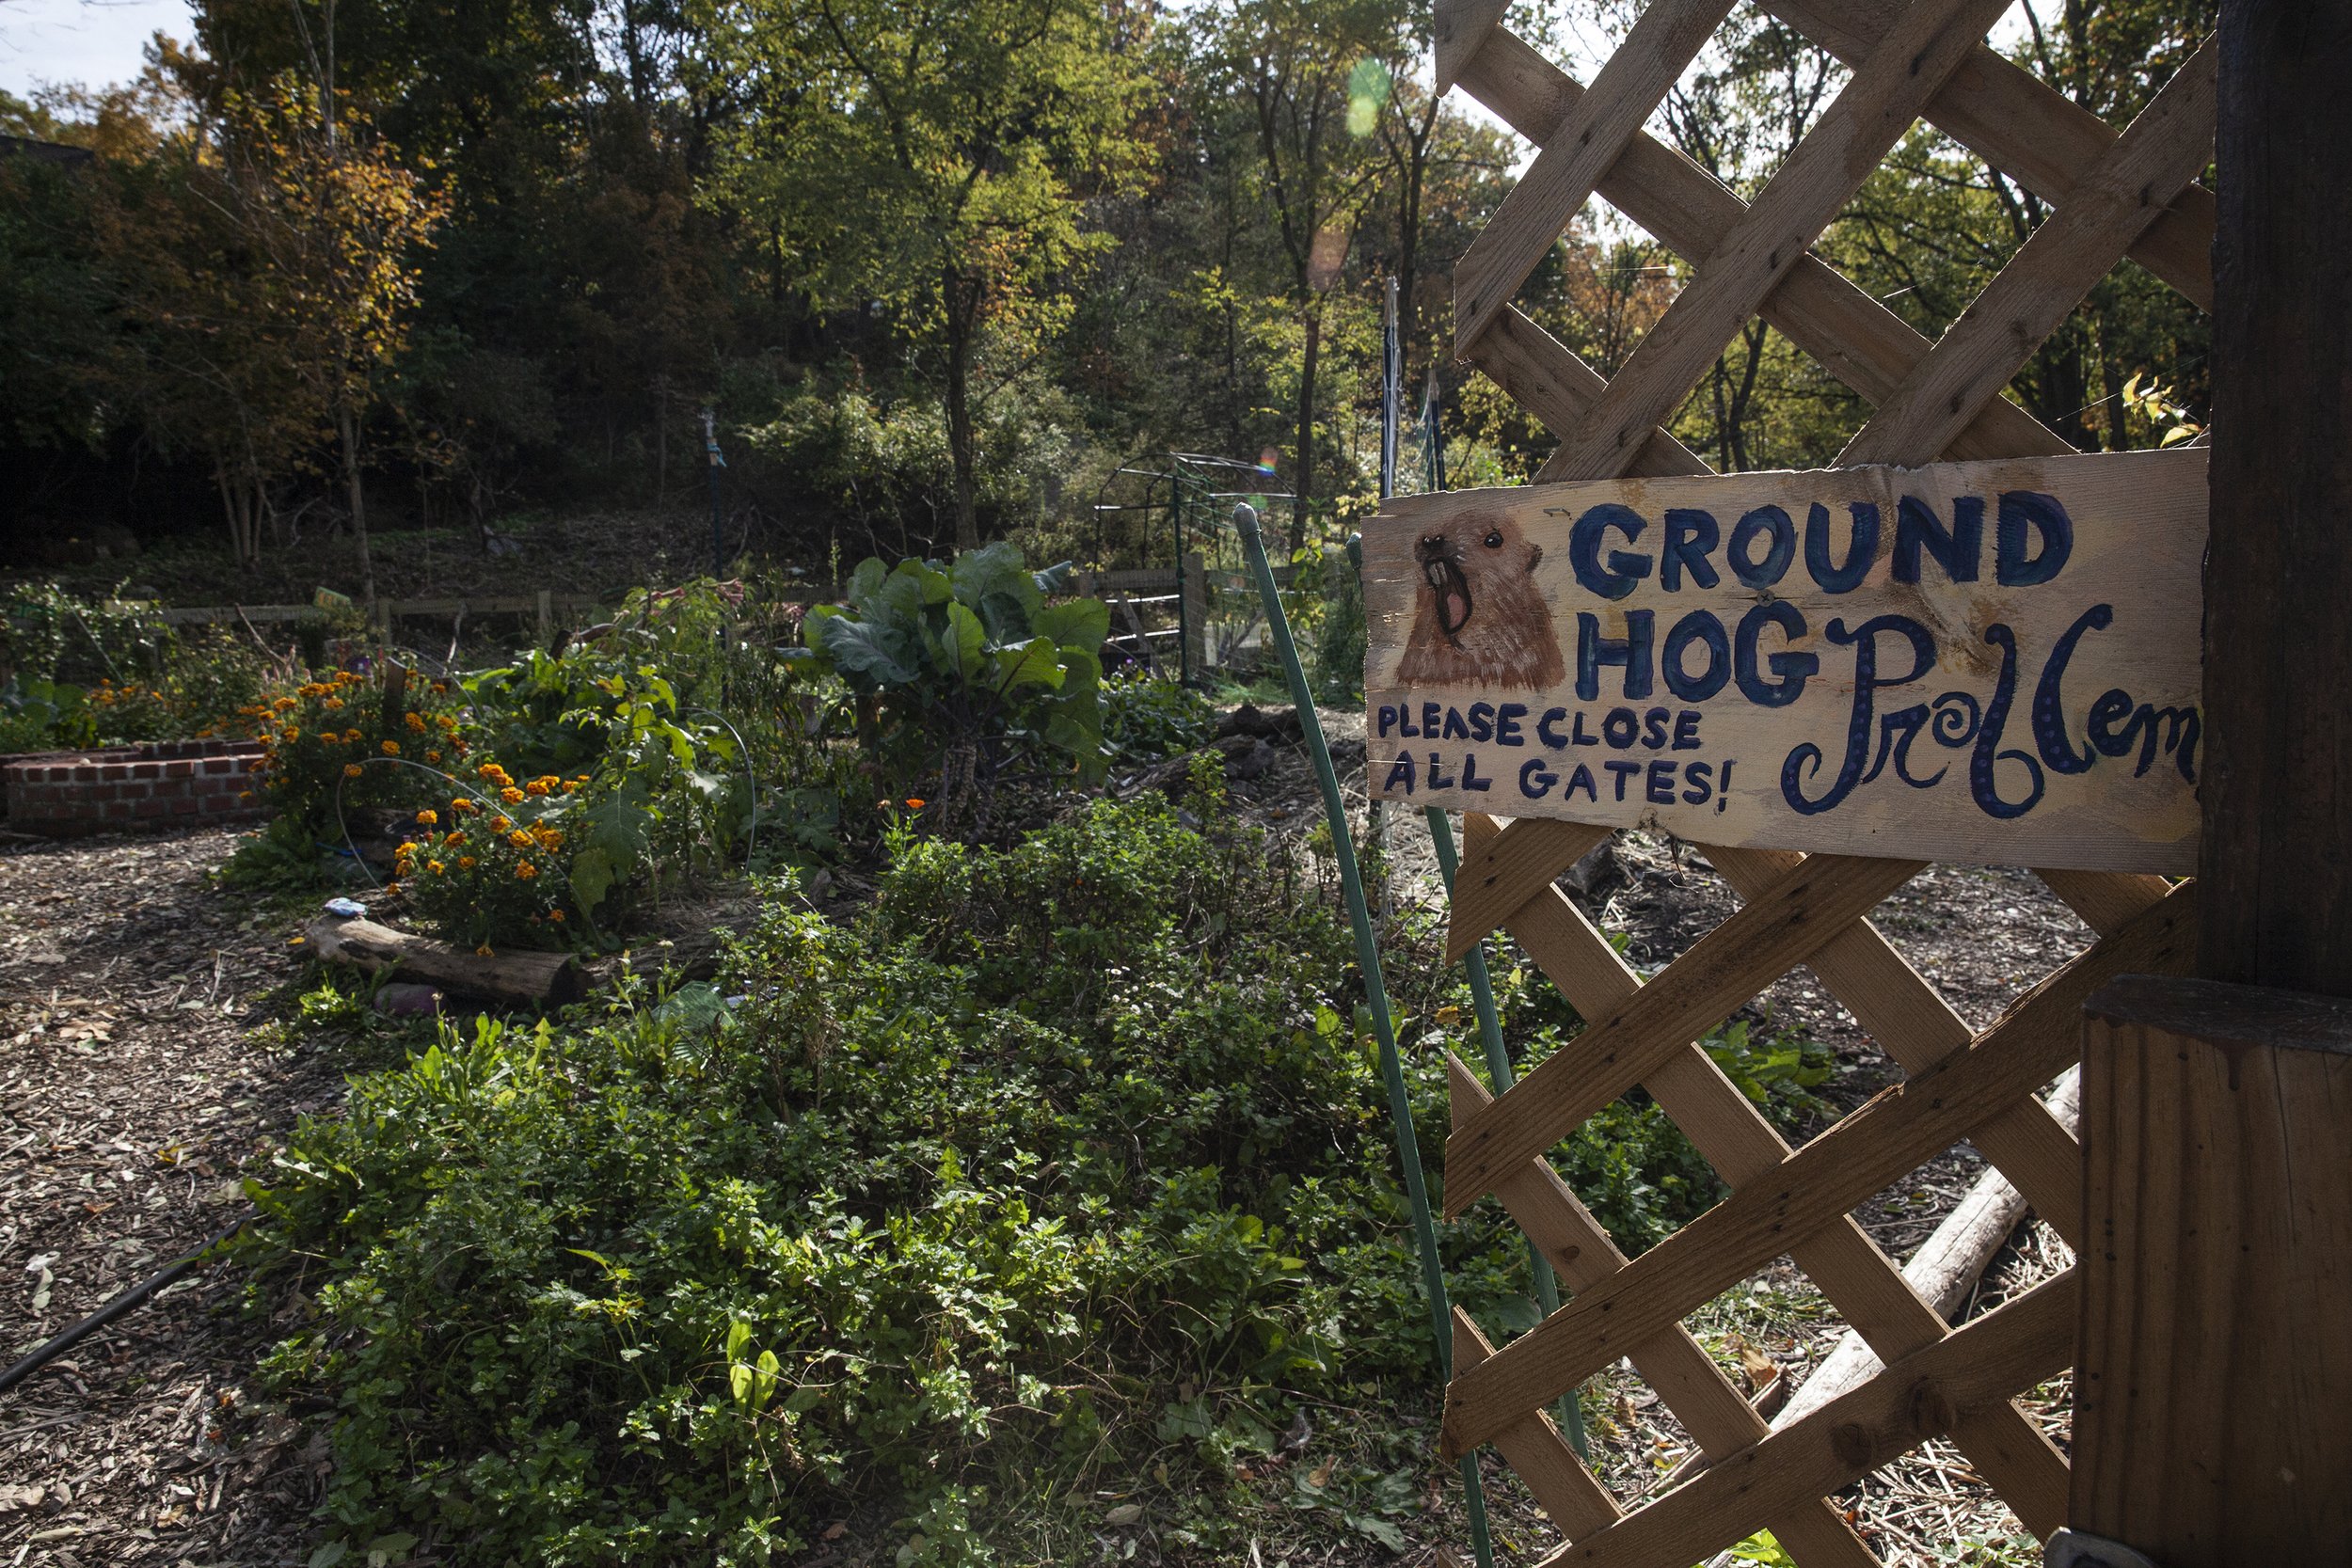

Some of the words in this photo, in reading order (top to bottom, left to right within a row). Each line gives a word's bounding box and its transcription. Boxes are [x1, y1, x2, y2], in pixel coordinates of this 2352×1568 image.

[1570, 491, 2073, 599] GROUND
[1577, 602, 1820, 706] HOG
[1379, 705, 1528, 746] PLEASE
[1538, 707, 1703, 751] CLOSE
[1385, 752, 1492, 795] ALL
[1519, 758, 1733, 814] GATES!
